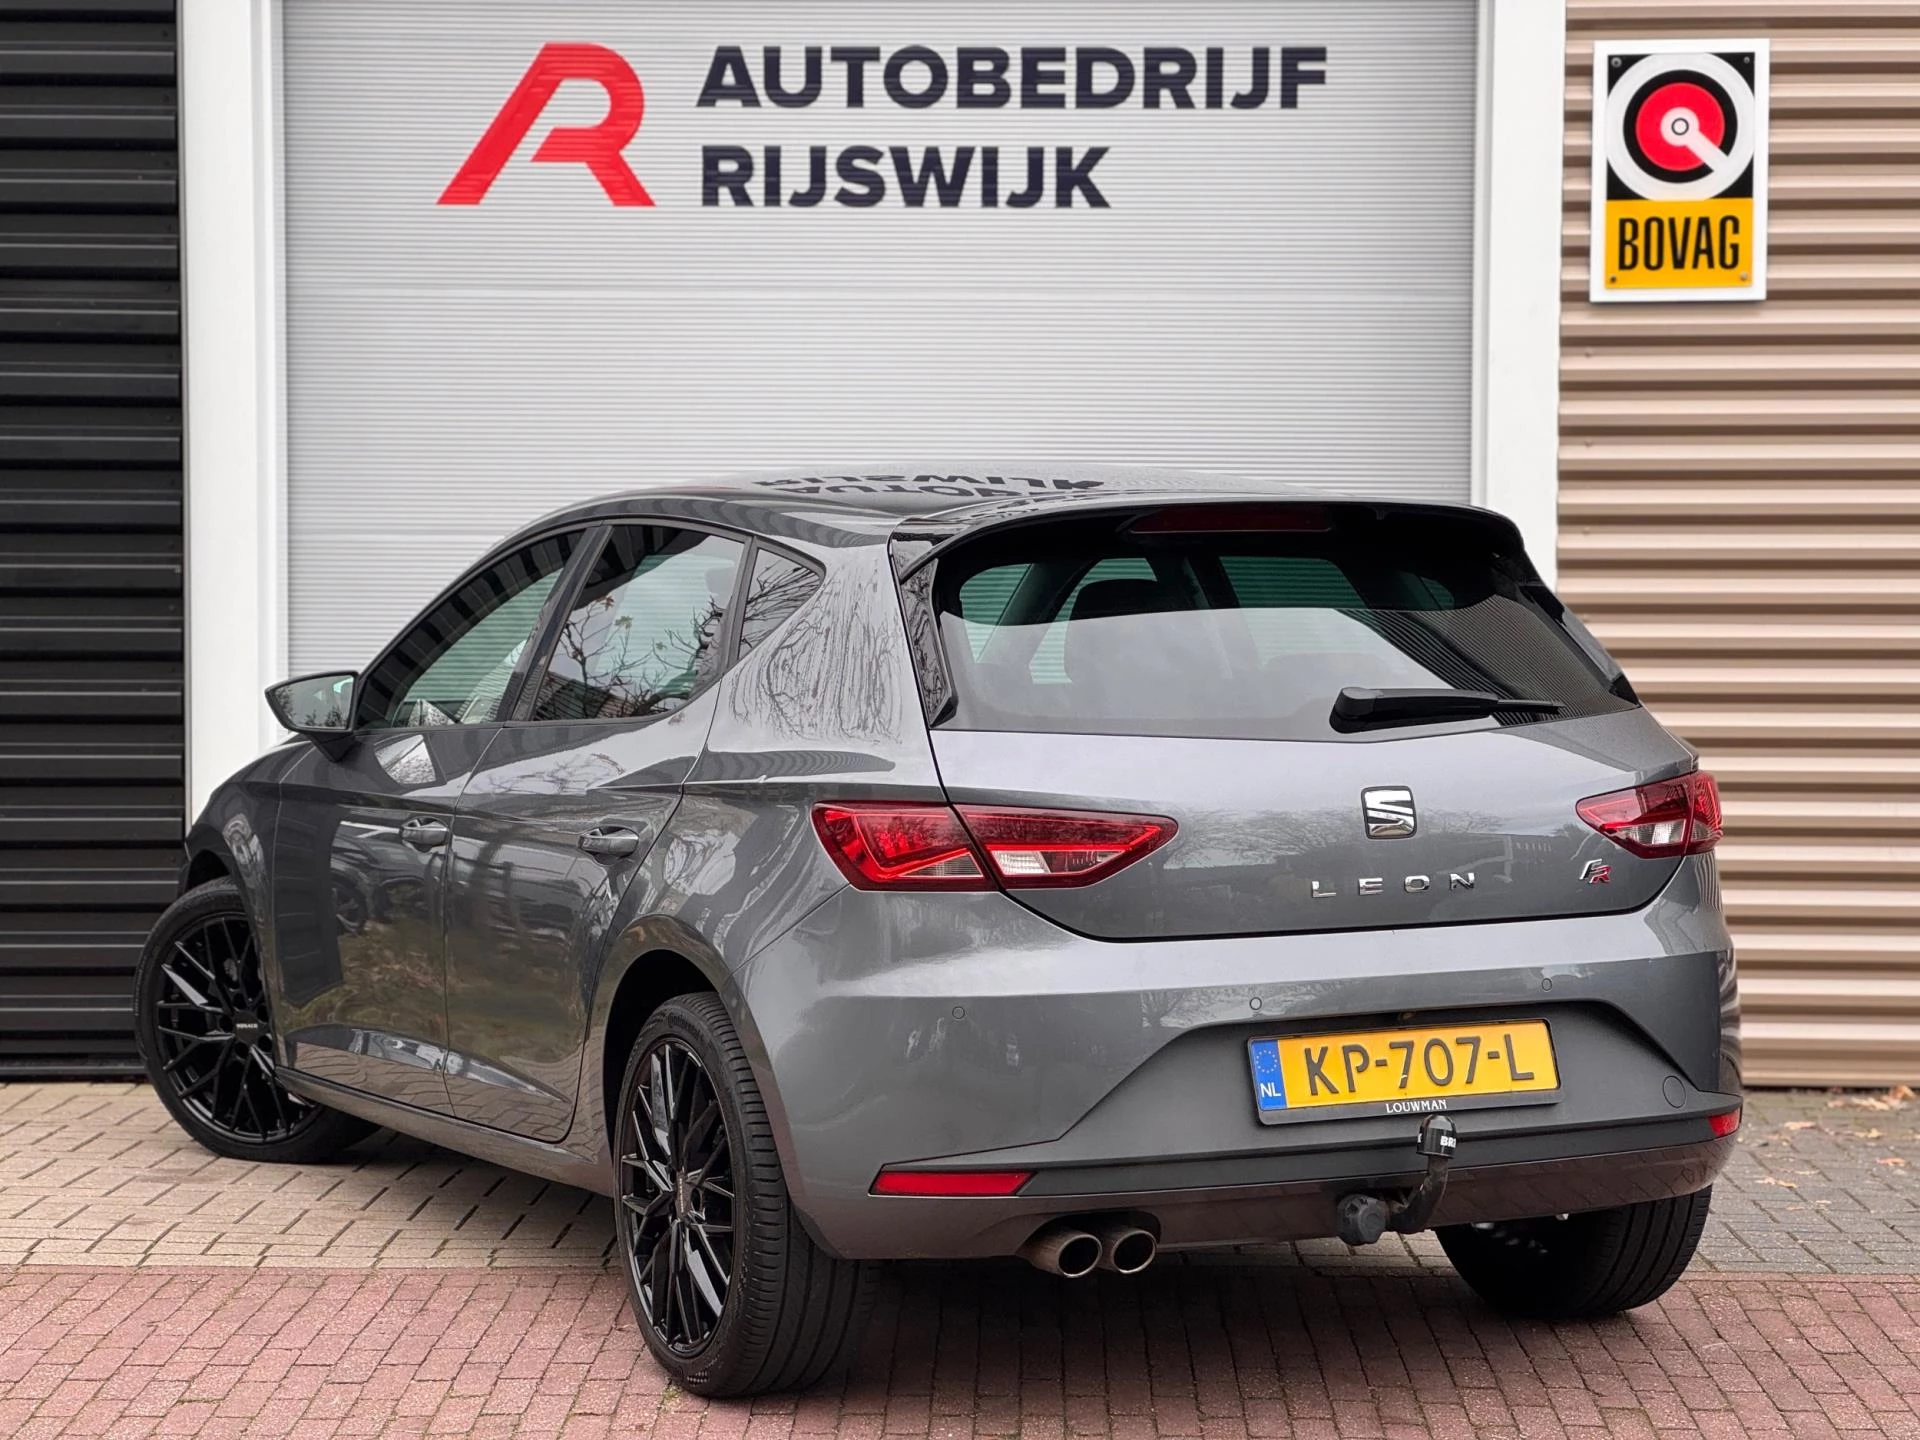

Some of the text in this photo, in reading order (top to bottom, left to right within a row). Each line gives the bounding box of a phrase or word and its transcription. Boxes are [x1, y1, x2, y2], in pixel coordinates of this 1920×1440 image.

[698, 46, 1326, 109] AUTOBEDRIJF
[703, 146, 1109, 208] RIJSWIJK
[1619, 215, 1740, 271] BOVAG
[1311, 872, 1475, 899] LEON
[1579, 858, 1612, 884] FR
[1304, 1034, 1535, 1096] KP-707-L
[1260, 1082, 1281, 1098] NL
[1385, 1099, 1447, 1113] LOUWMAN
